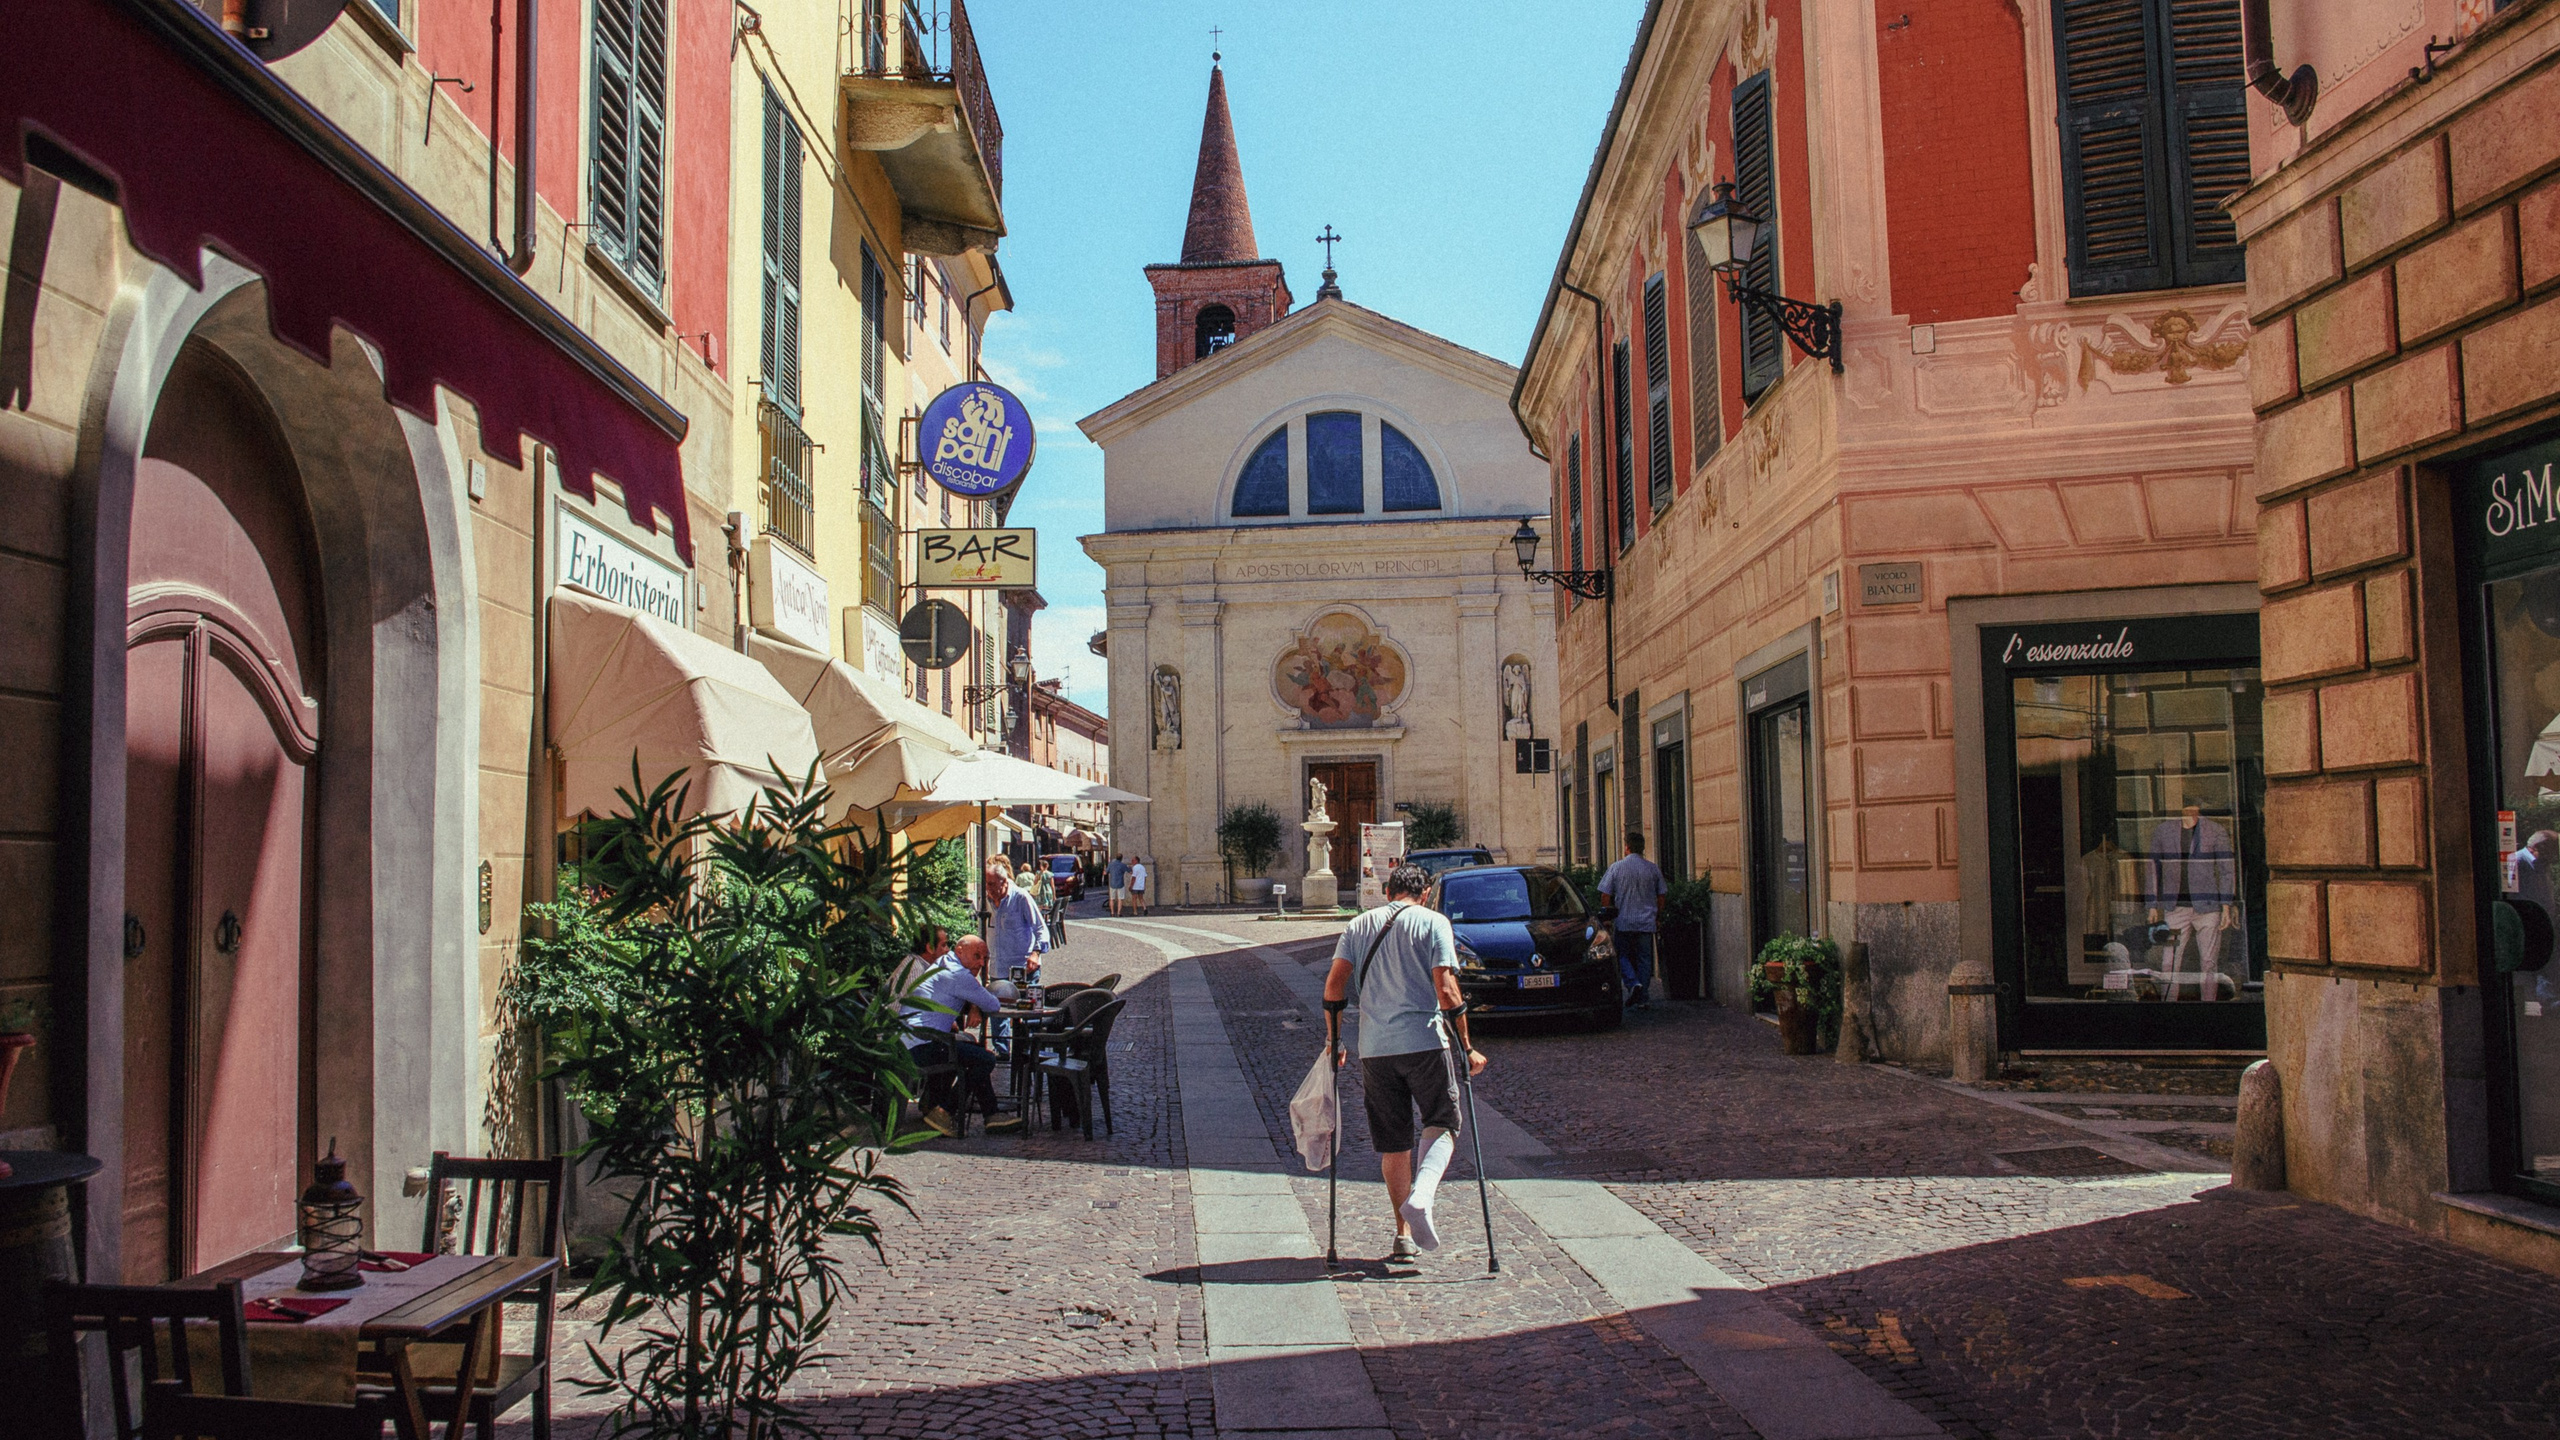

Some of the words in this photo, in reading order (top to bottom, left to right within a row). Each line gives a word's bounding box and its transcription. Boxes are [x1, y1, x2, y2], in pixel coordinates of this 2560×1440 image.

[934, 436, 1004, 472] paul
[932, 461, 998, 488] discobar
[924, 534, 1030, 563] BAR
[567, 530, 679, 625] Erboristeria
[1235, 561, 1365, 578] APOSTOLORVM
[1874, 571, 1907, 580] VICOLO
[1867, 583, 1916, 596] BIANCHI
